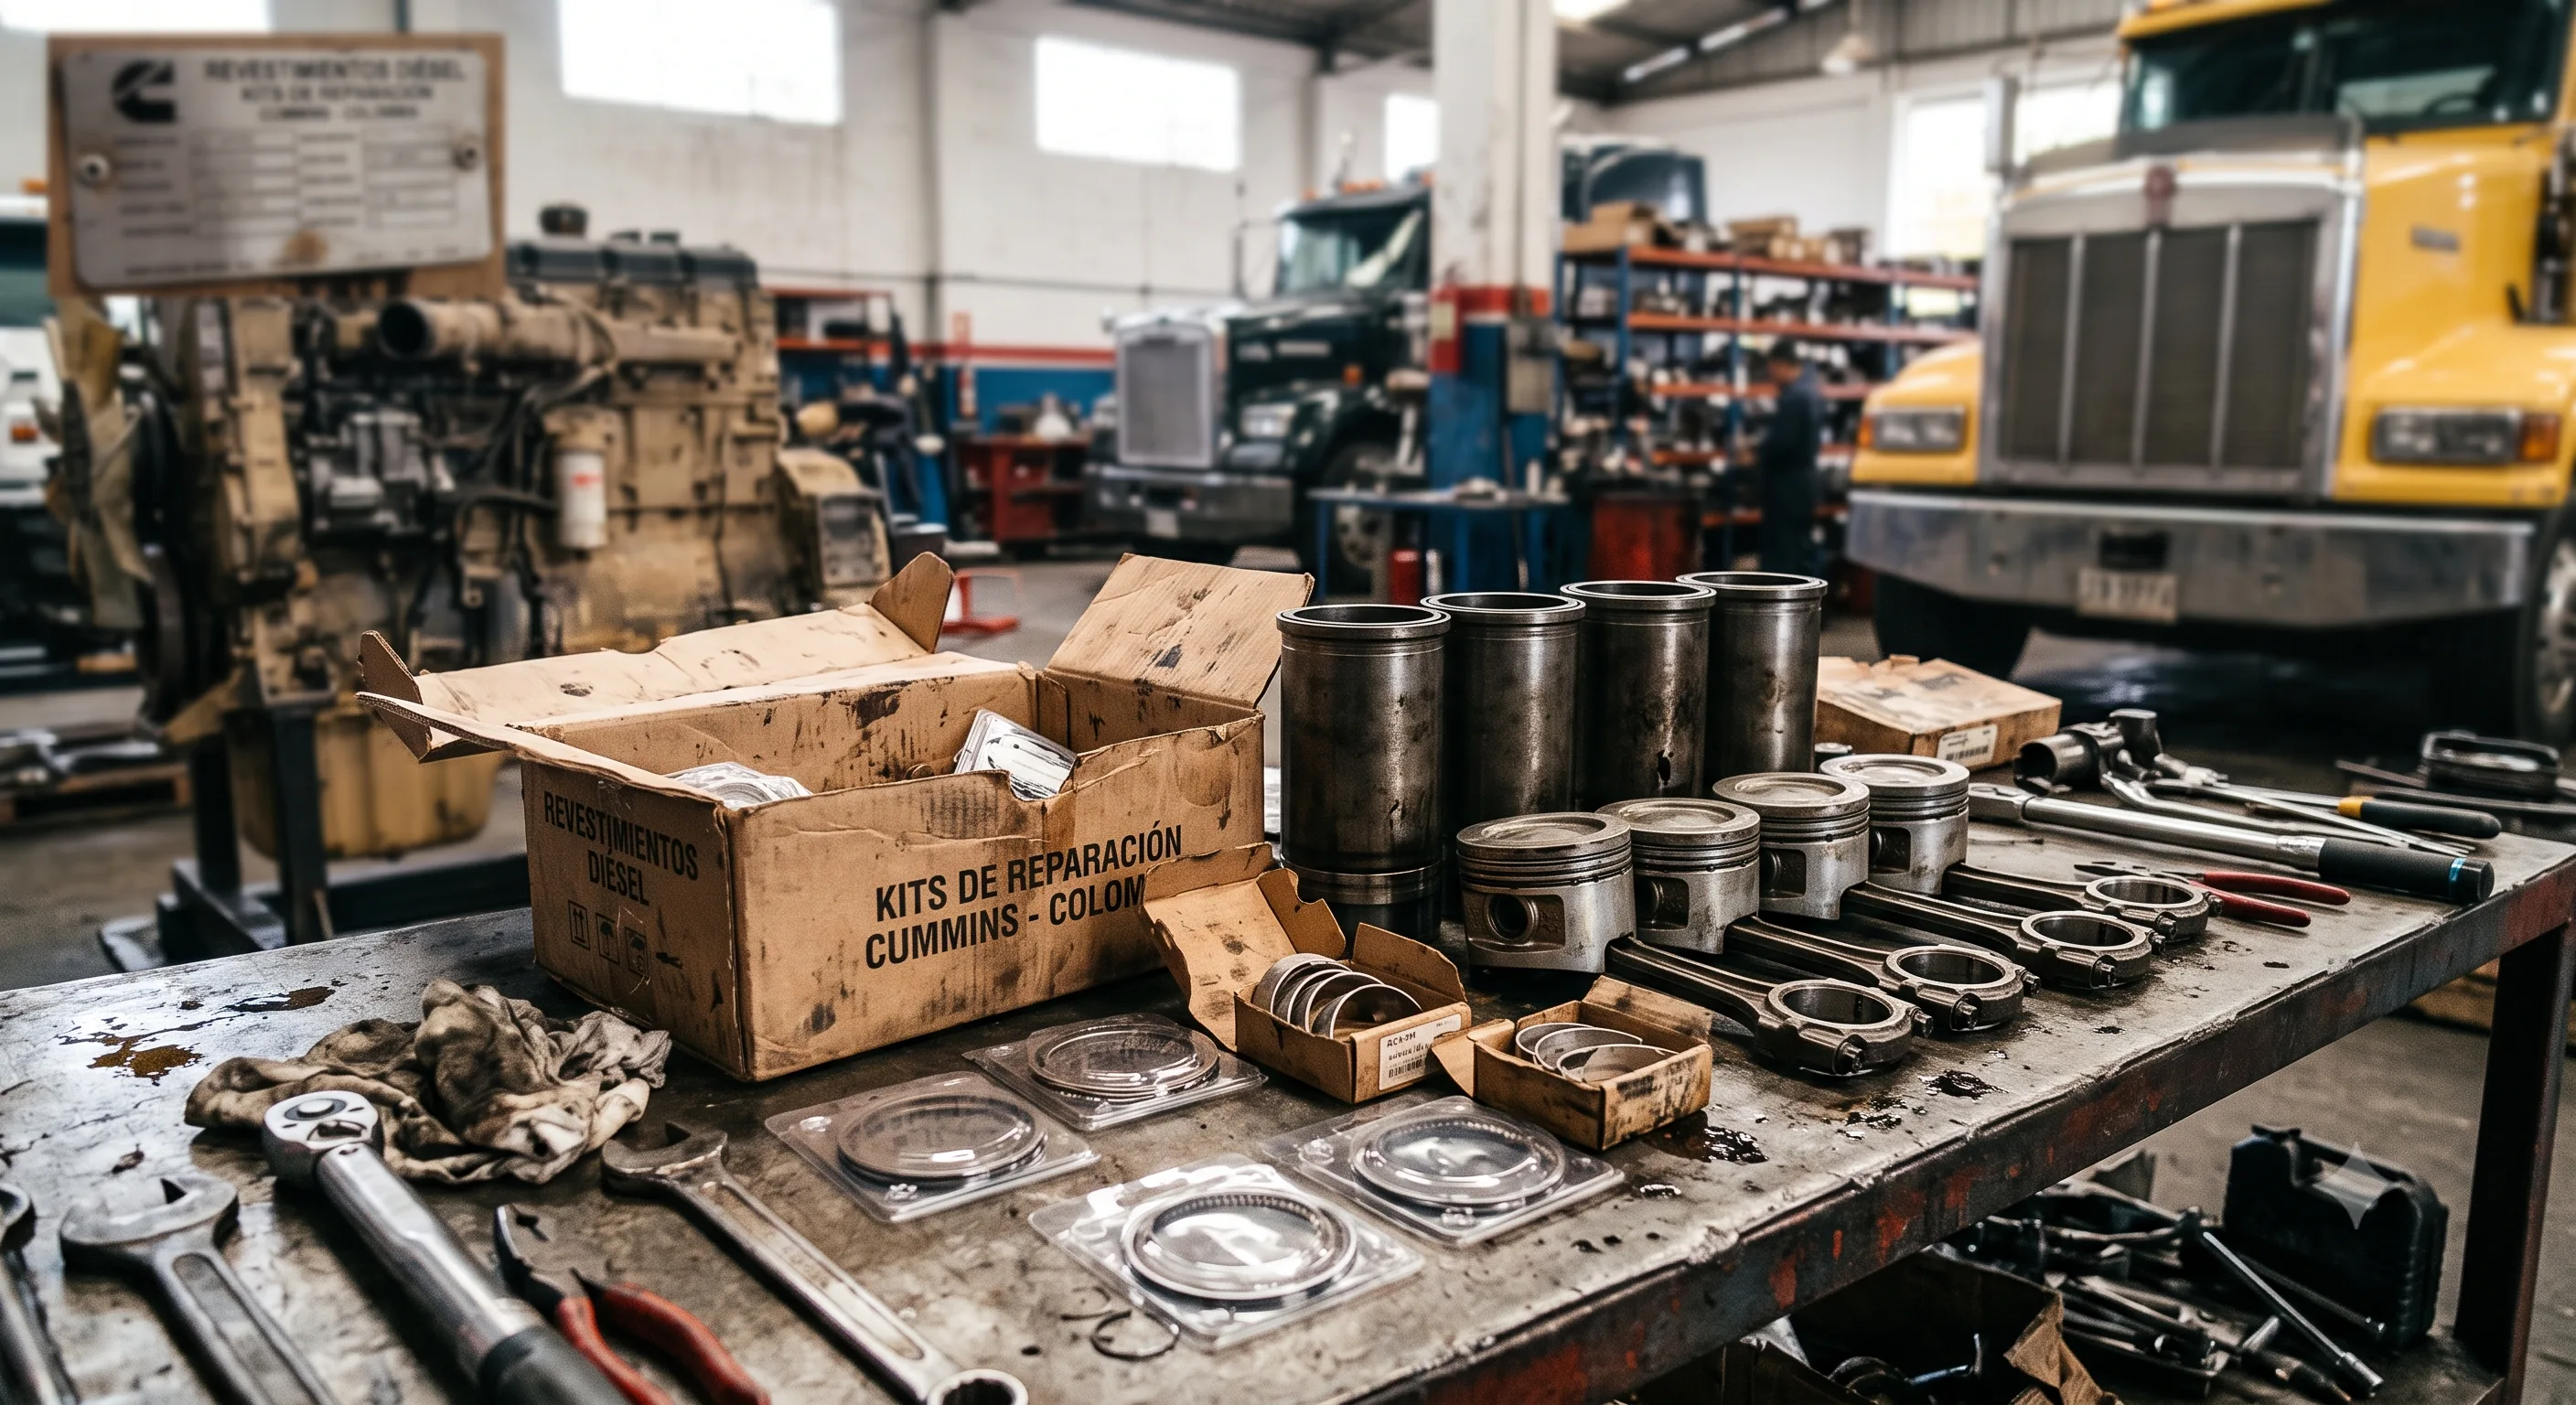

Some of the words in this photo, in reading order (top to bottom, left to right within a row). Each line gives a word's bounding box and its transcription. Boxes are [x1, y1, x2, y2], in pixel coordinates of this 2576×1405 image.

[544, 790, 698, 881] REVESTIMIENTOS
[587, 849, 649, 906] DIÉSEL
[875, 874, 948, 922] KITS
[959, 863, 998, 905] DE
[1007, 820, 1182, 894] REPARACIÓN
[865, 903, 1019, 970] CUMMINS
[1028, 913, 1040, 923] -
[1049, 873, 1146, 926] COLOM
